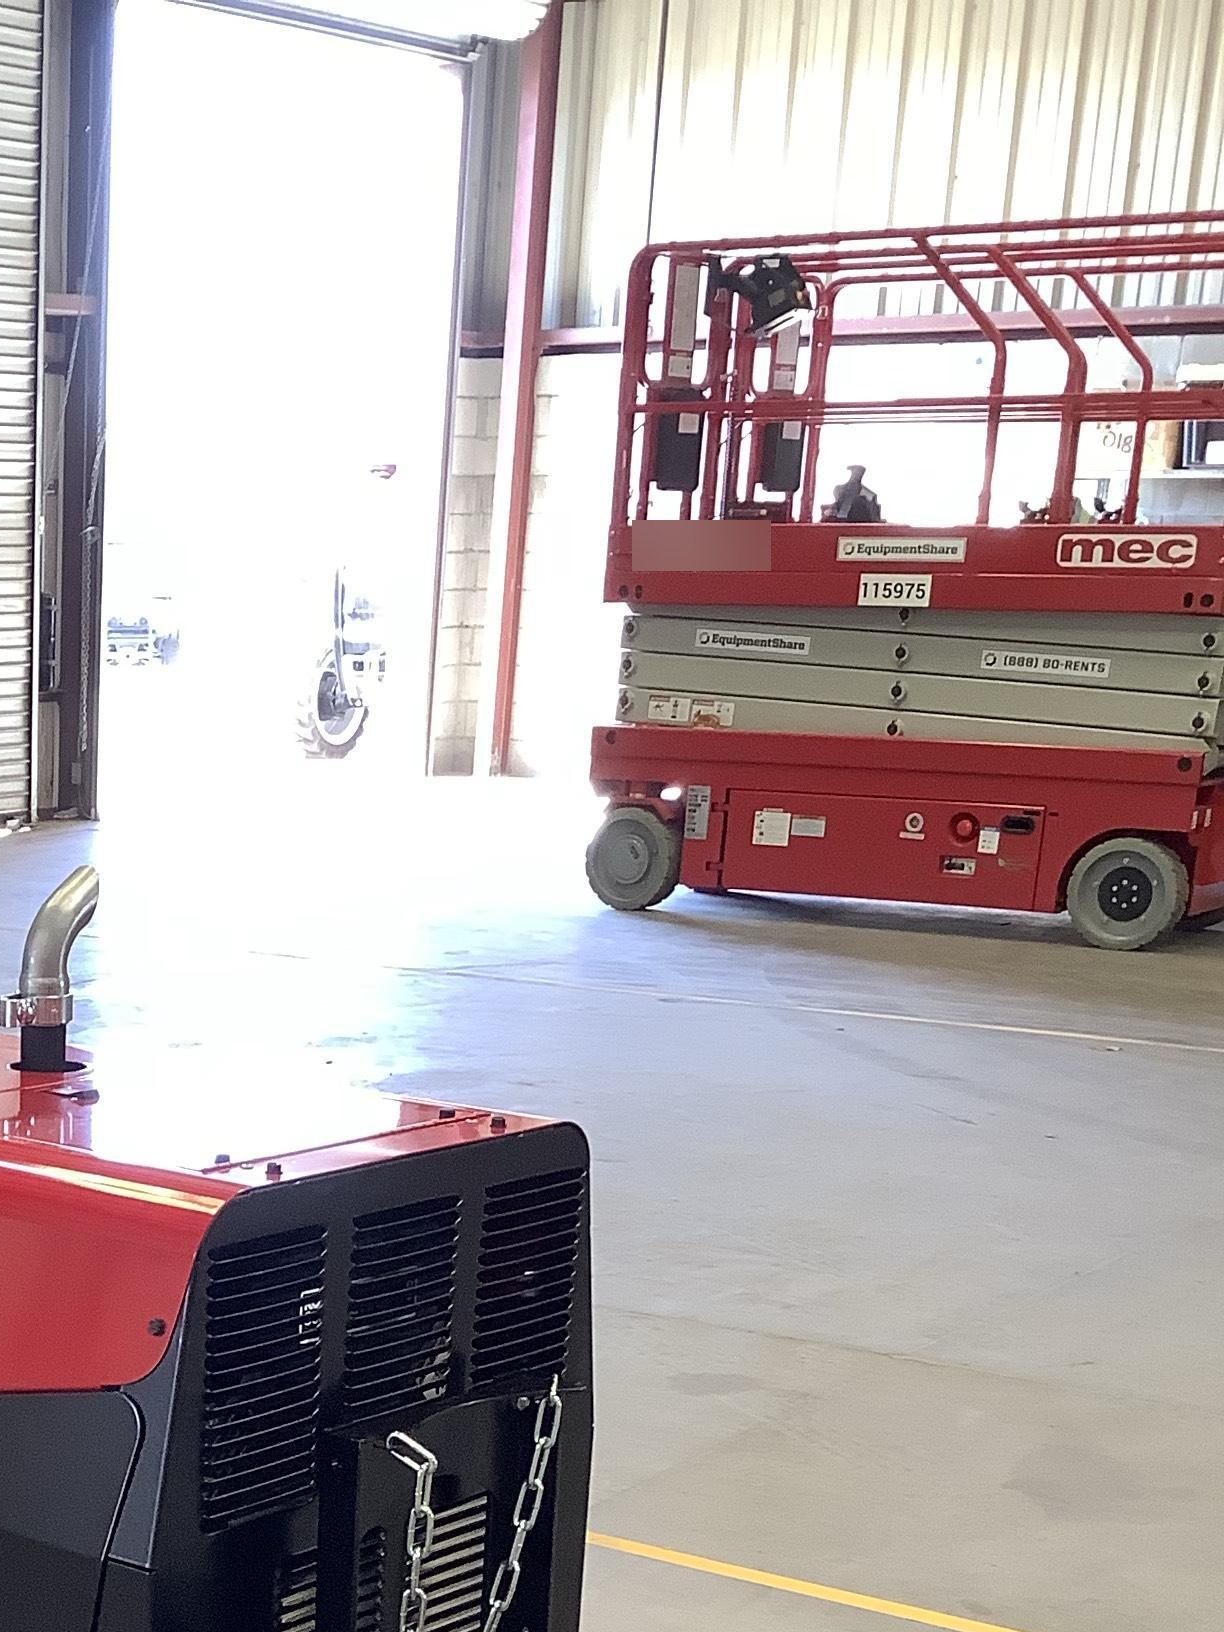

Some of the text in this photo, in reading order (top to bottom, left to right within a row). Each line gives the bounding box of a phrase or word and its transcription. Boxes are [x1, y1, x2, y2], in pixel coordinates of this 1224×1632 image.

[856, 543, 958, 556] EquipmentShare
[1059, 538, 1194, 564] mec
[861, 582, 926, 599] 115975
[711, 633, 805, 650] EquipmentShare
